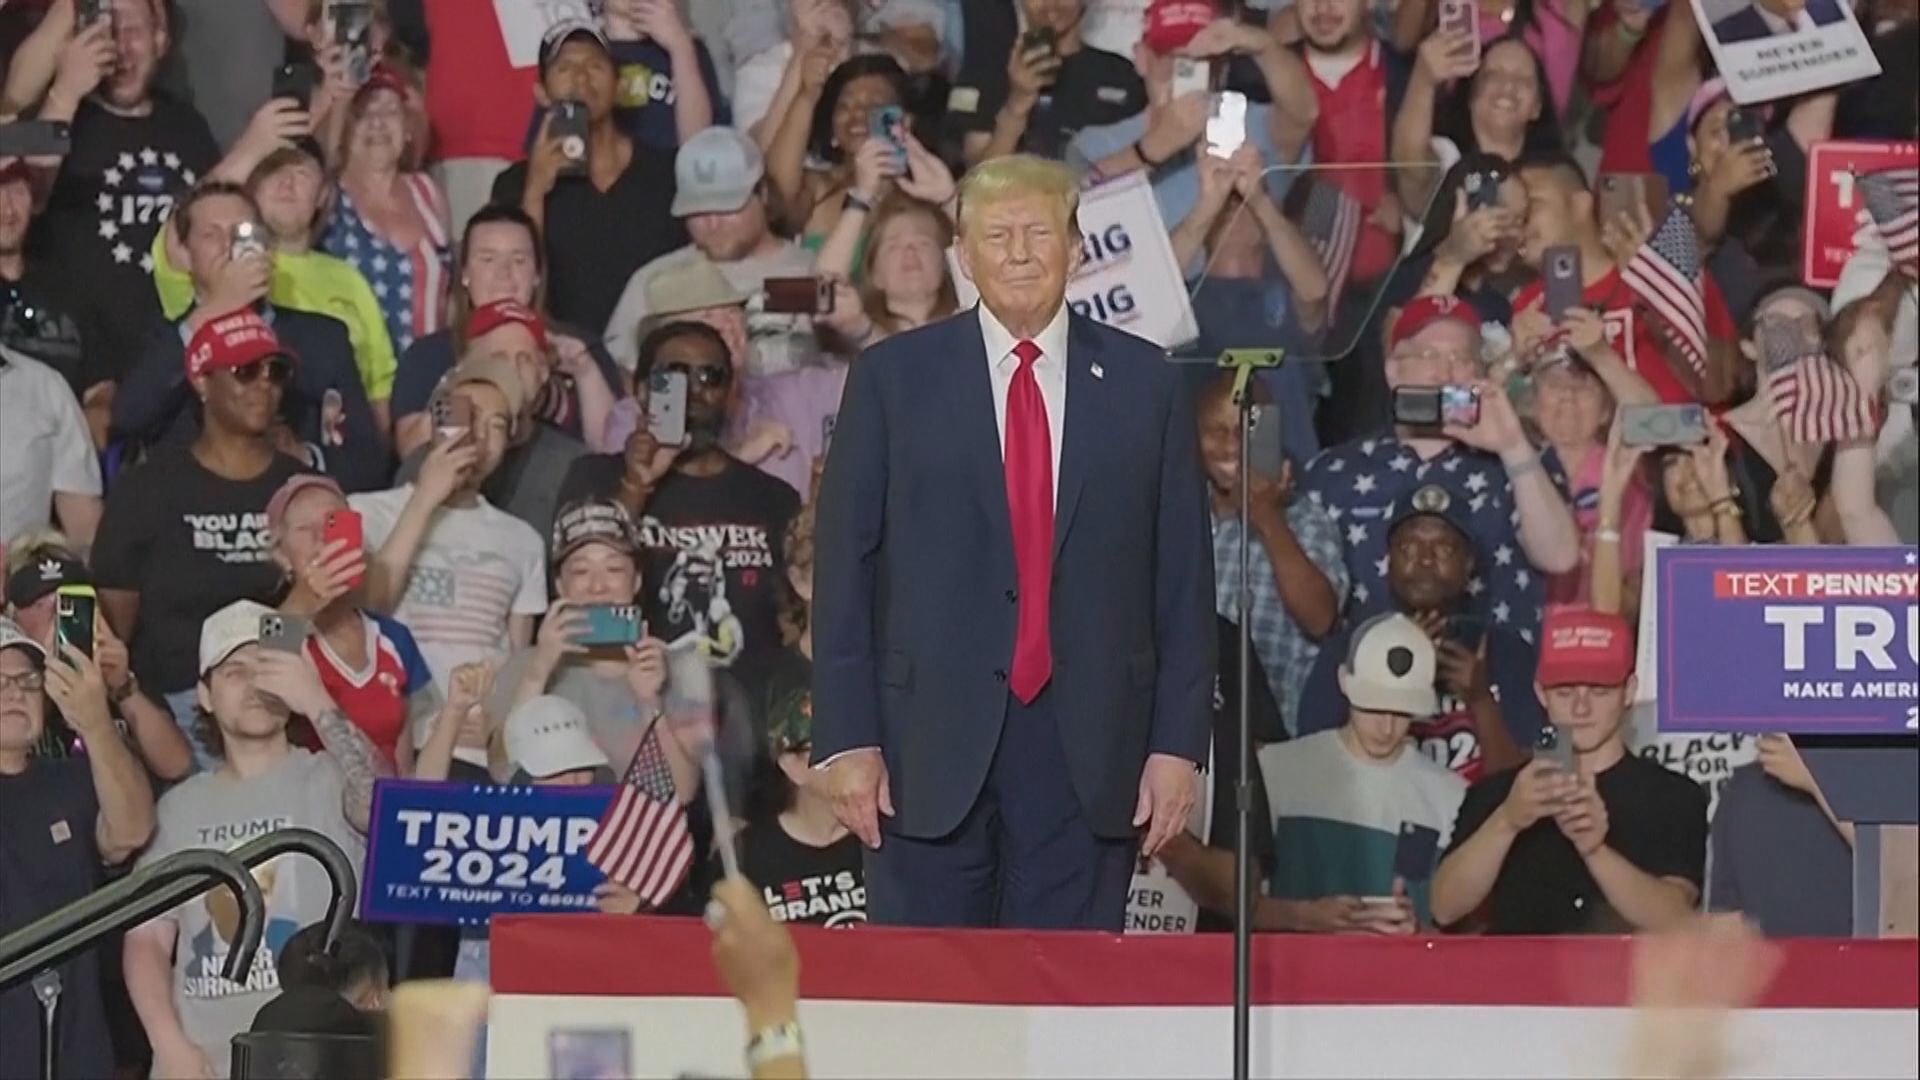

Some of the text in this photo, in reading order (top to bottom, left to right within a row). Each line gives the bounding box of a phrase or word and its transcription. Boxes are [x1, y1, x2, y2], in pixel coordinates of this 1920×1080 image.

[726, 552, 773, 567] 2024
[1727, 572, 1918, 596] TEXT PENNSY
[1764, 605, 1918, 670] TR
[1783, 681, 1844, 698] MAKE
[198, 817, 287, 843] TRUMP
[396, 810, 599, 856] TRUMP
[419, 848, 566, 890] 2024
[386, 884, 432, 899] TEXT
[438, 886, 503, 904] TRUMP
[510, 890, 533, 905] TO
[763, 870, 855, 905] LET'S
